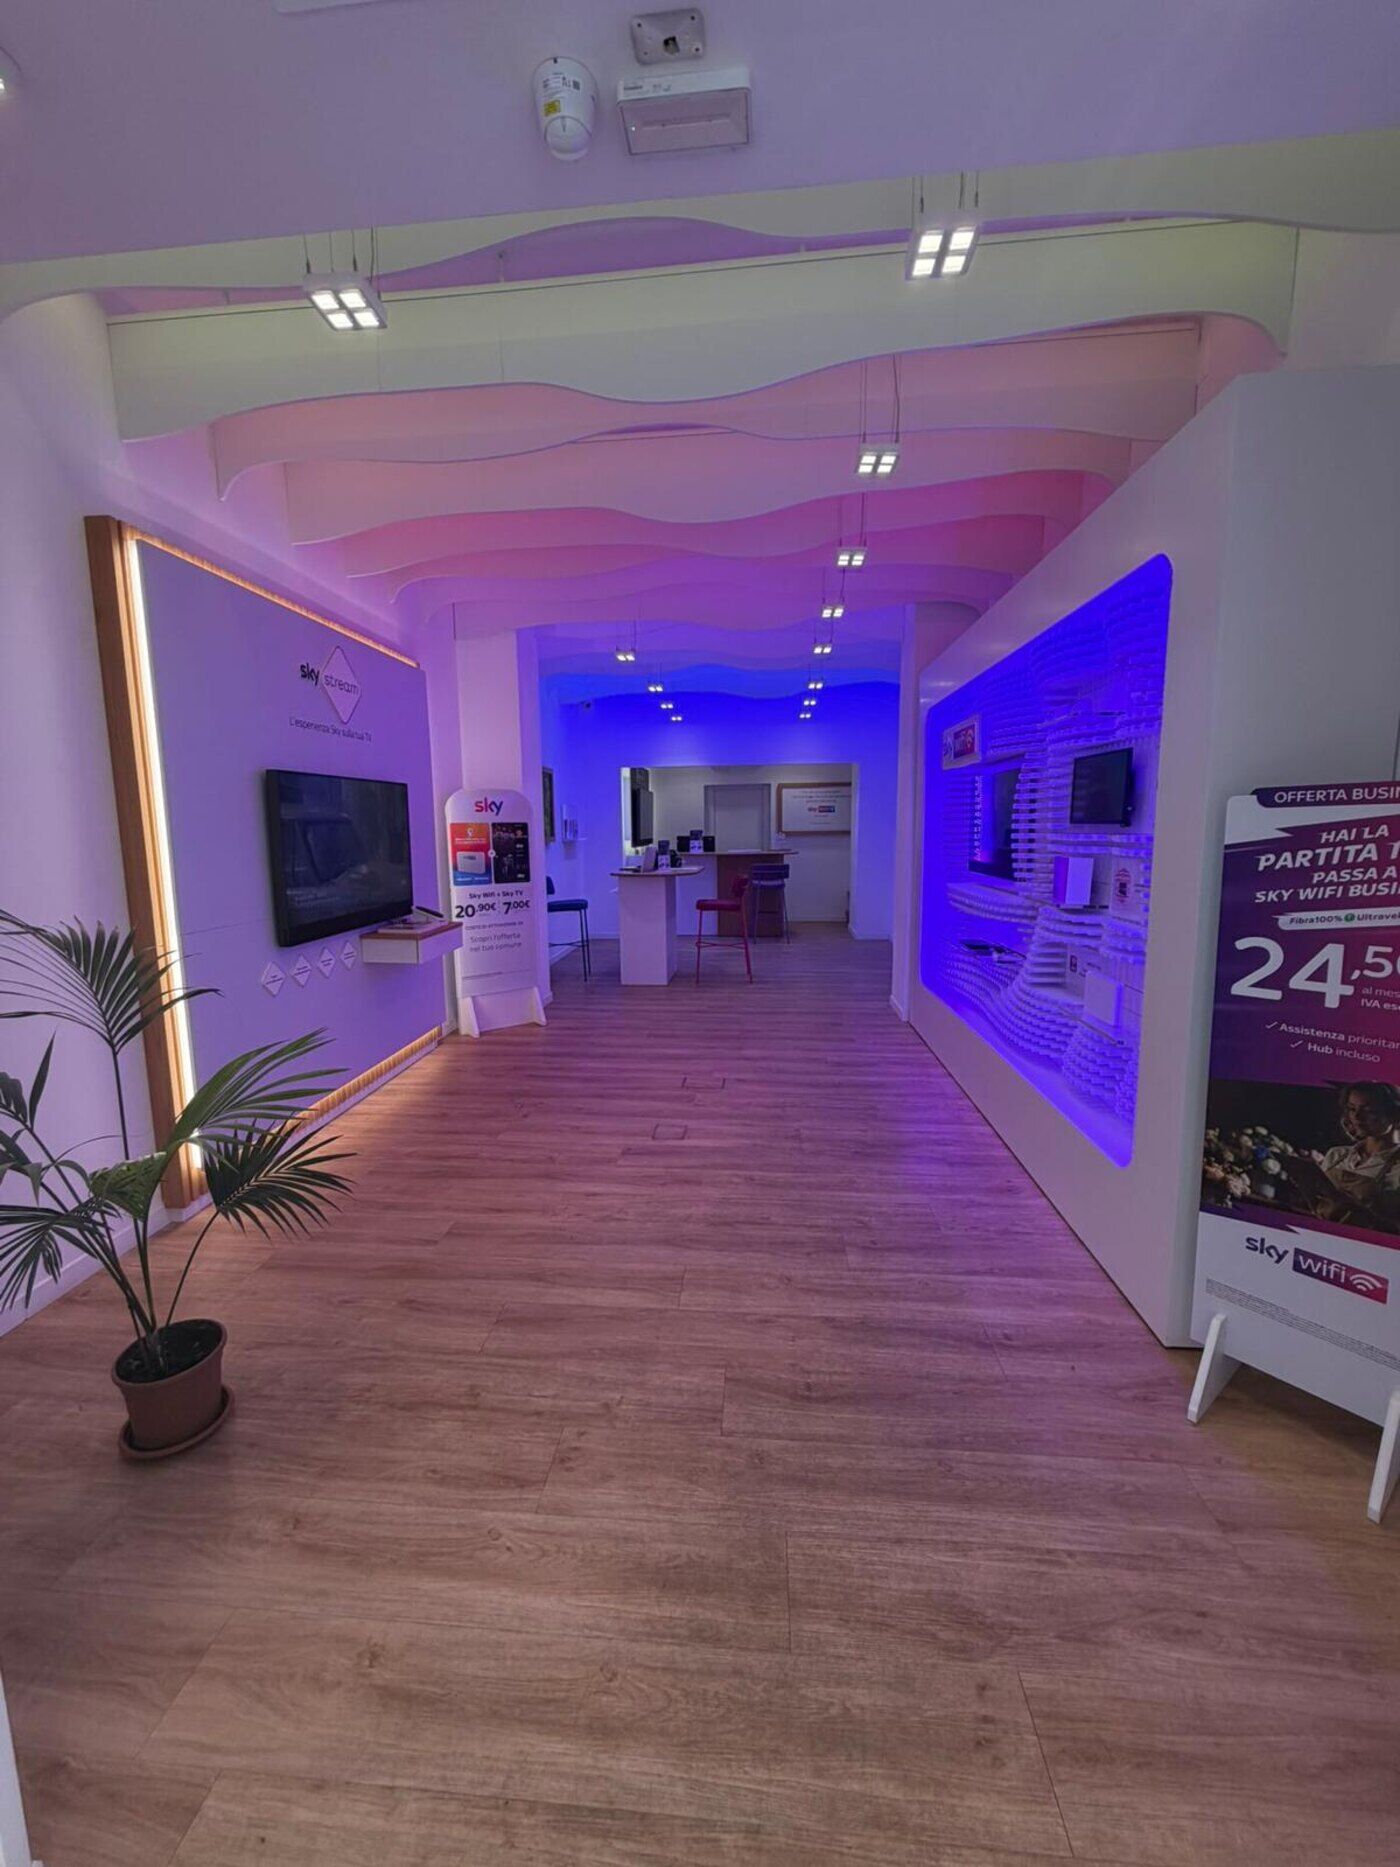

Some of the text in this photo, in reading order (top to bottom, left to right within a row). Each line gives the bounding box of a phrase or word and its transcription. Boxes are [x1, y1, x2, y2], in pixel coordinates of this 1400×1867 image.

[300, 662, 359, 696] sky stream
[1274, 789, 1348, 804] OFFERTA
[474, 797, 504, 816] sky
[1320, 824, 1390, 844] HAI LA
[1256, 843, 1379, 872] PARTITA
[1312, 865, 1398, 884] PASSA A
[468, 892, 481, 900] Sky
[501, 890, 514, 898] Sky
[1254, 881, 1400, 903] SKY WIFI BUSI
[1230, 936, 1400, 1009] 24,5
[1362, 986, 1373, 995] al
[1361, 998, 1380, 1009] IVA
[1280, 1023, 1345, 1041] Assistenza
[1308, 1042, 1381, 1062] Hub incluso
[1245, 1236, 1347, 1283] sky wifi
